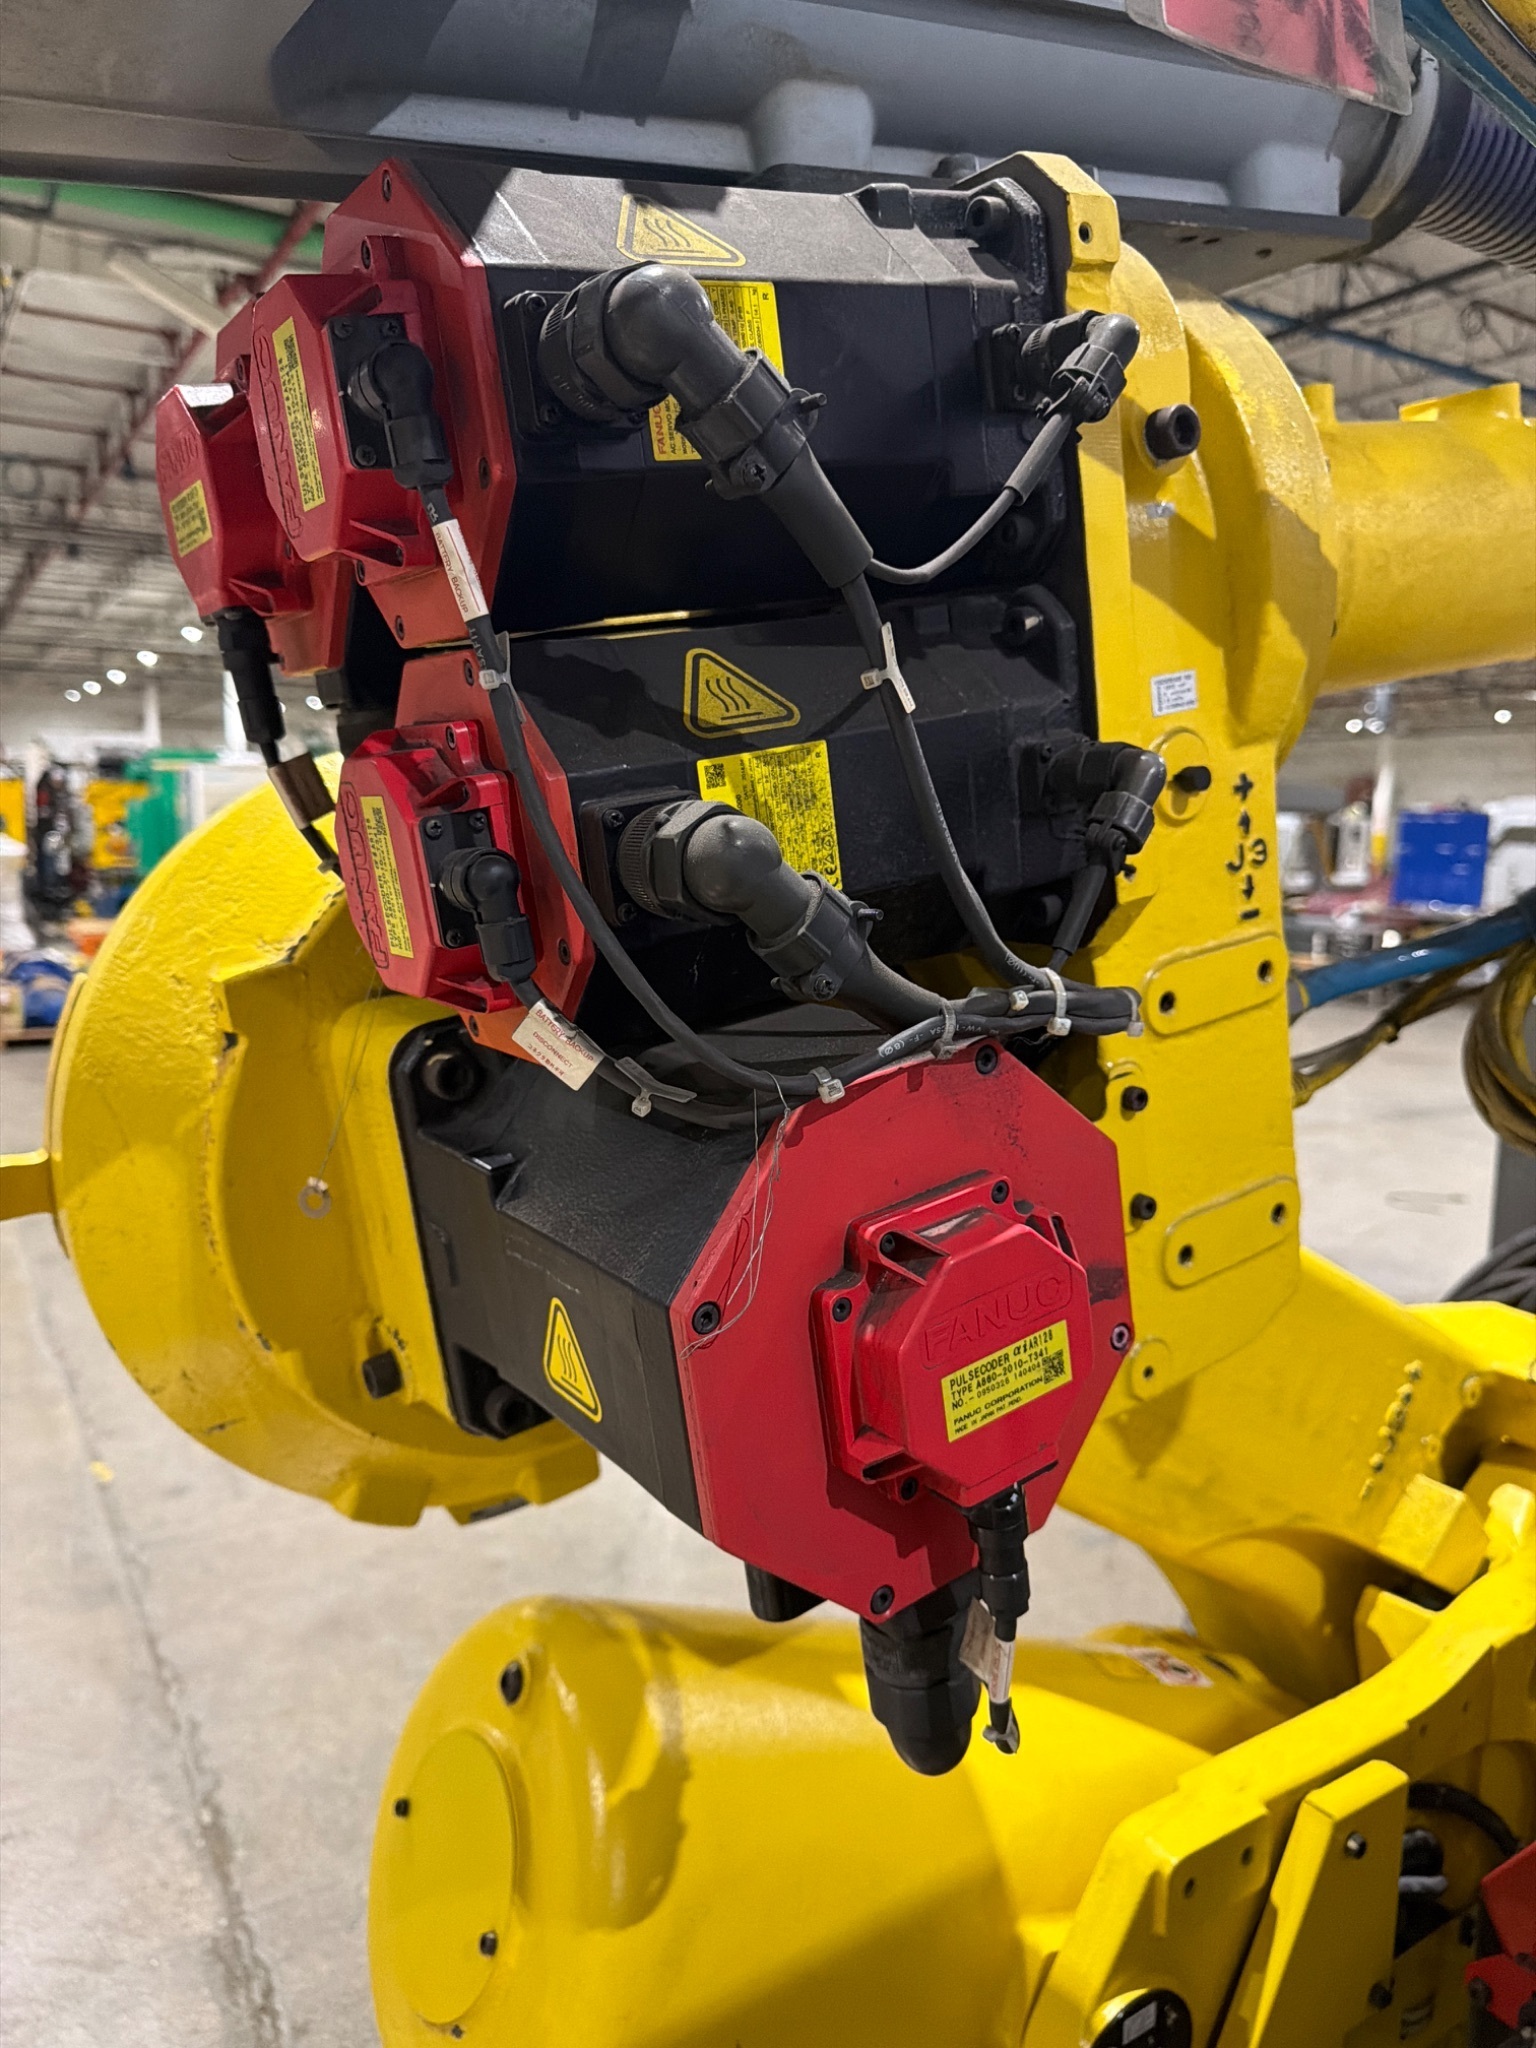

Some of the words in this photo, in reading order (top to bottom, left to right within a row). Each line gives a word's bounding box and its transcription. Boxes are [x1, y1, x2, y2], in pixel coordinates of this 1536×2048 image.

[762, 292, 770, 301] R
[653, 405, 667, 454] FANUC
[666, 413, 675, 441] SERVO
[671, 444, 677, 455] AC
[435, 531, 454, 574] BATTERY
[451, 577, 470, 614] BACKUP
[469, 627, 488, 669] SAFIT
[1225, 838, 1267, 873] J3
[378, 875, 396, 948] PULSECODER
[533, 1031, 573, 1068] DISCONNECT
[536, 1009, 567, 1038] BATTERY
[565, 1037, 594, 1061] BACKUP
[923, 1276, 1062, 1362] FANUC
[949, 1352, 1010, 1391] PULSECODER
[1013, 1361, 1041, 1380] 140404
[951, 1382, 973, 1400] TYPE
[953, 1406, 982, 1426] FANUC
[984, 1376, 1043, 1410] CORPORATION
